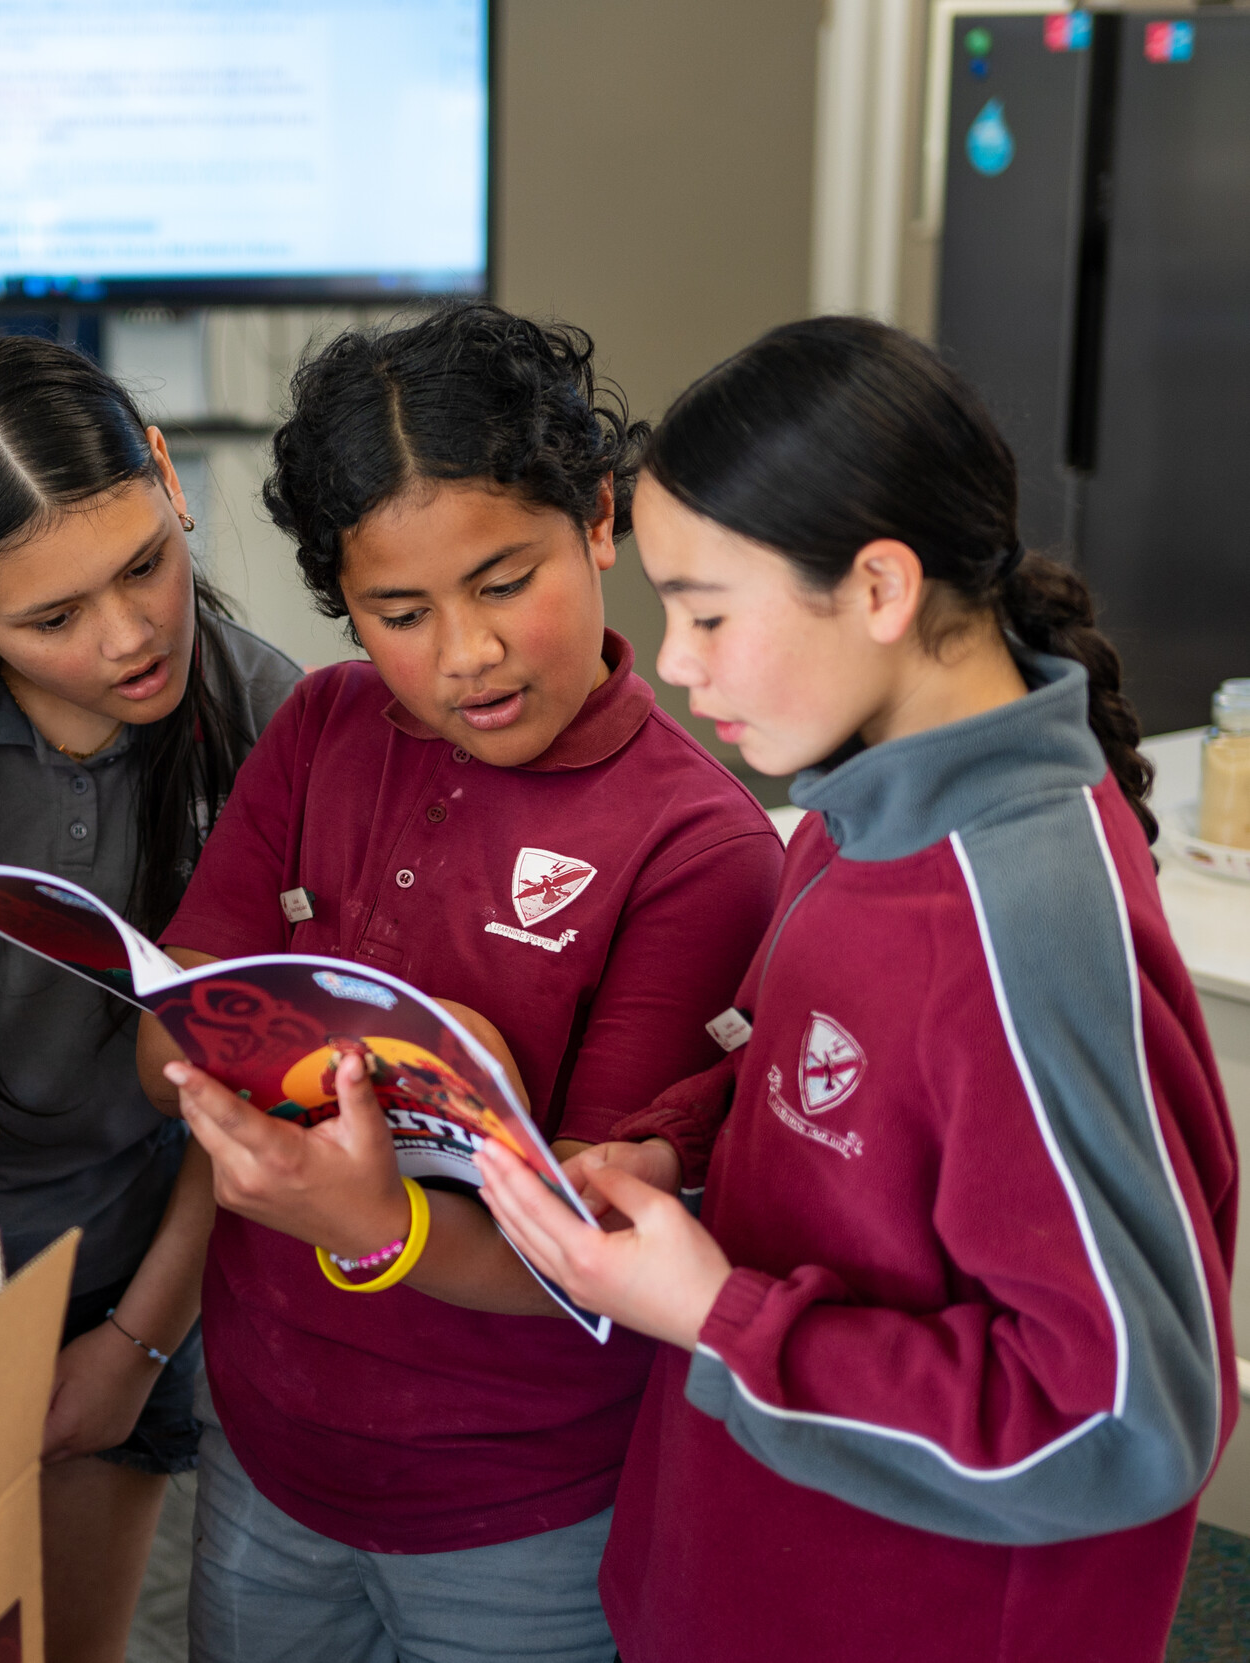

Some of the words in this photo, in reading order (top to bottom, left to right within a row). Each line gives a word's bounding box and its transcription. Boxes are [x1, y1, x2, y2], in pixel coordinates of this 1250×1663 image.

[493, 924, 525, 938] LEARNING
[525, 932, 538, 943] FOR
[540, 938, 553, 948] LIFE
